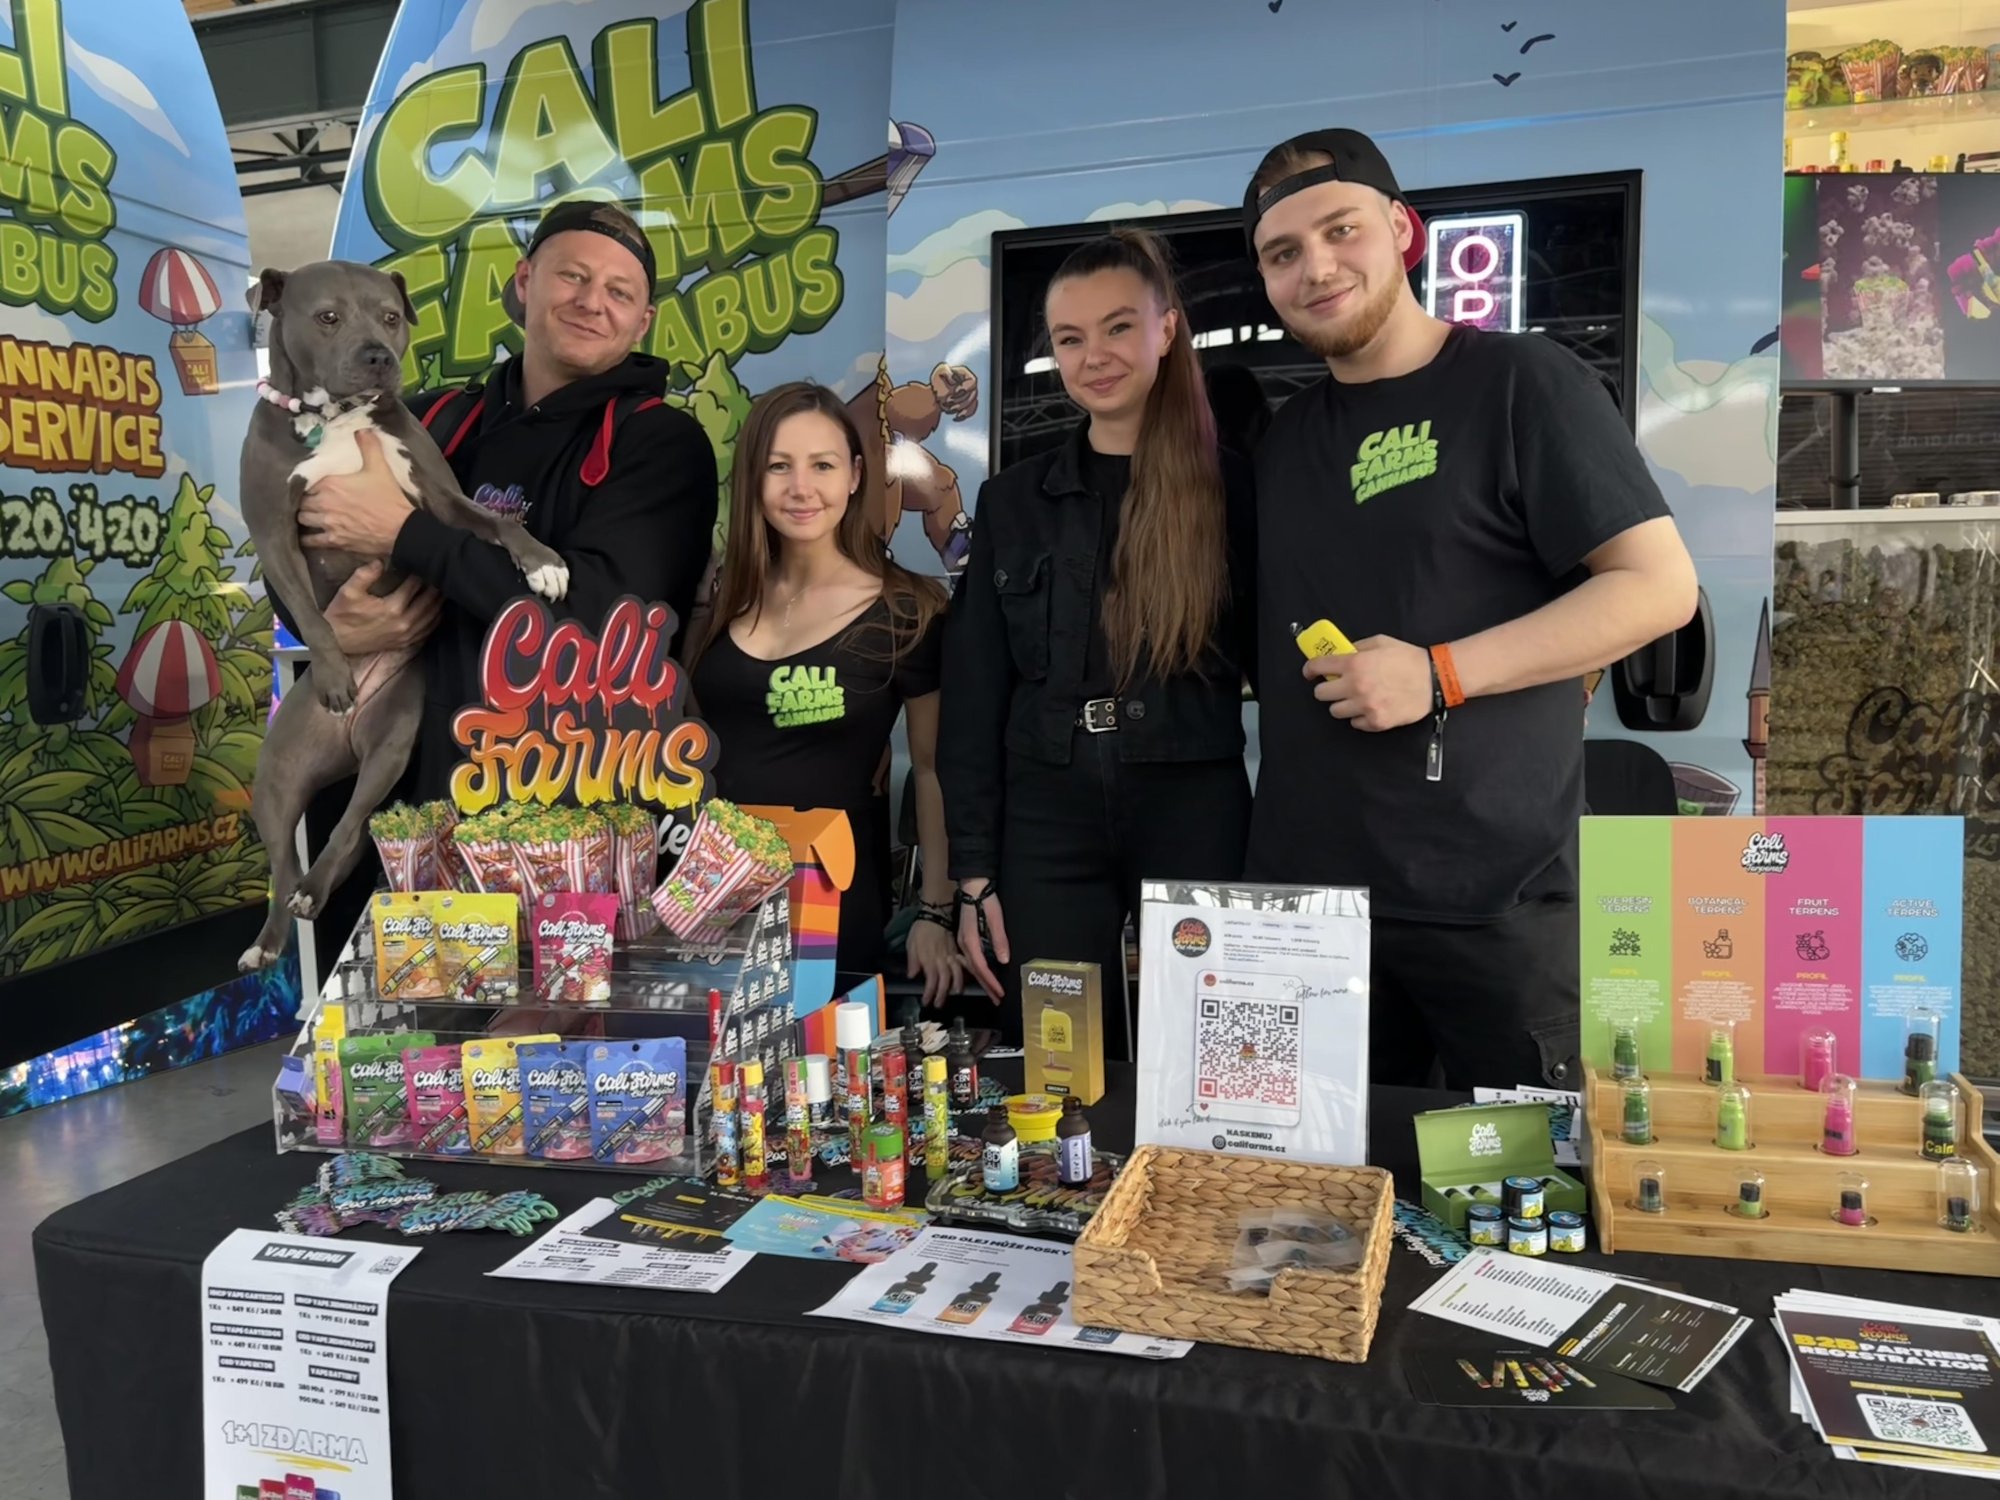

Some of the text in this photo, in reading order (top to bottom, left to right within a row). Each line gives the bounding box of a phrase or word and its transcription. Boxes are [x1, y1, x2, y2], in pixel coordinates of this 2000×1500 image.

[366, 0, 757, 248] CALI
[1357, 420, 1432, 462] CALI
[1350, 438, 1439, 491] FARMS
[483, 599, 677, 712] Cali
[768, 664, 836, 692] CALI
[766, 686, 845, 714] FARMS
[449, 712, 711, 818] Farms
[1750, 833, 1784, 850] Cali
[1742, 848, 1789, 865] Farms
[1602, 905, 1650, 914] TERPENS
[1688, 897, 1746, 906] BOTANICAL
[1695, 905, 1743, 914] TERPENS
[1797, 899, 1829, 907] FRUIT
[1892, 899, 1932, 908] ACTIVE
[1789, 907, 1839, 916] TERPENS
[1888, 908, 1938, 917] TERPENS
[439, 924, 469, 941] Cali
[538, 919, 567, 937] Cali
[350, 1062, 386, 1079] Cali
[413, 1069, 449, 1087] Cali
[472, 1068, 507, 1087] Cali
[528, 1069, 560, 1087] Cali
[953, 1073, 970, 1081] CBN
[595, 1072, 631, 1092] Cali
[1227, 1141, 1286, 1153] califarms.cz
[931, 1232, 959, 1241] CBD
[959, 1236, 990, 1246] OLEJ
[989, 1239, 1024, 1251] MŮŽE
[263, 1246, 347, 1264] VAPE MENU
[1793, 1333, 1989, 1363] B2B PARTNERS
[1799, 1346, 1989, 1372] REGISTRATION
[222, 1420, 368, 1465] 1+1 ZDARMA
